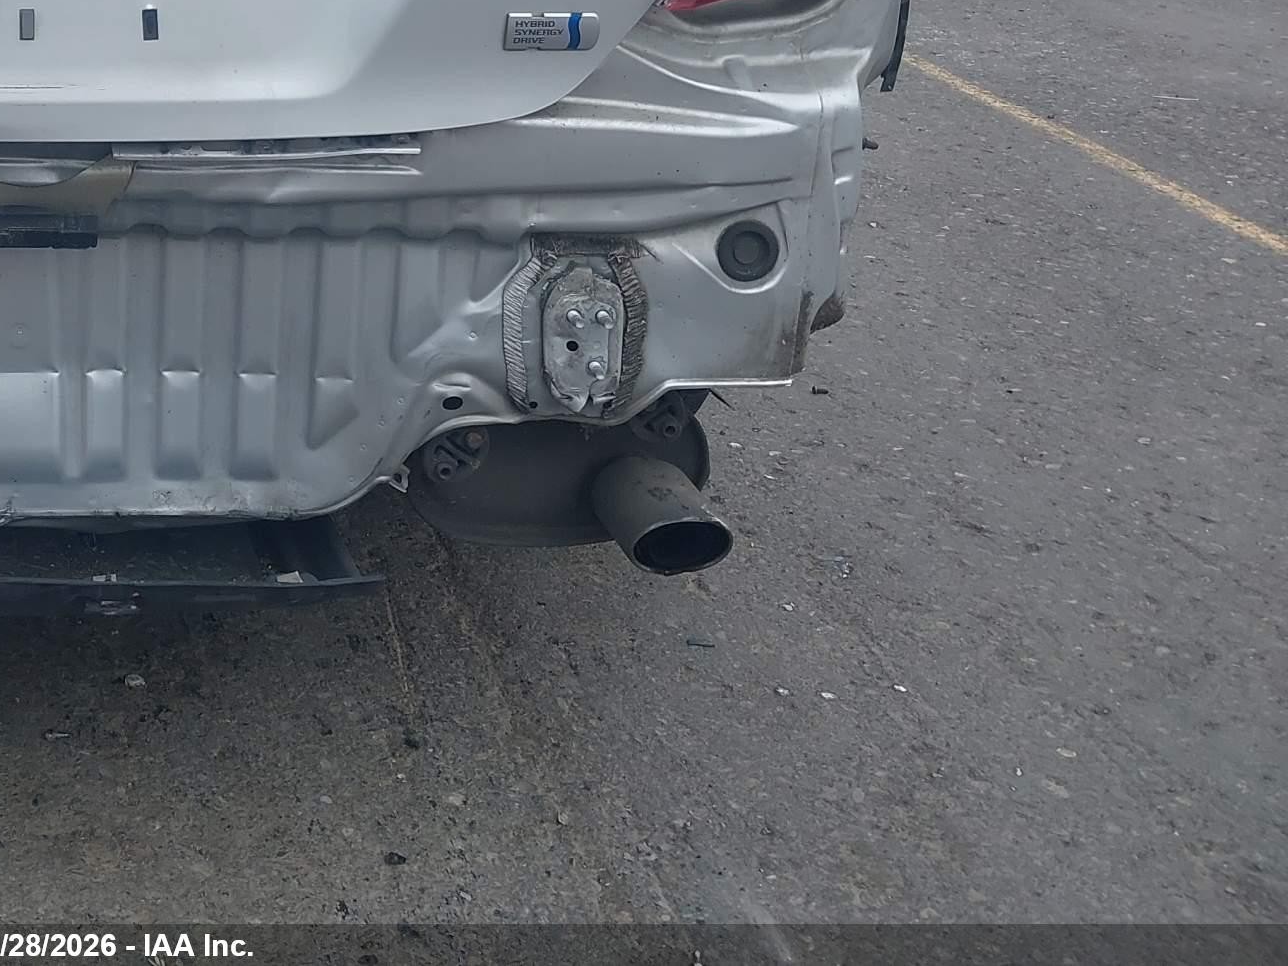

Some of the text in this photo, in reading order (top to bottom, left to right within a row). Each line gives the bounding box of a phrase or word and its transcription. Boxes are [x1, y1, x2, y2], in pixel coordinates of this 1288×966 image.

[515, 20, 556, 28] HYBRID
[514, 28, 564, 36] SYNERGY
[512, 36, 545, 44] DRIVE
